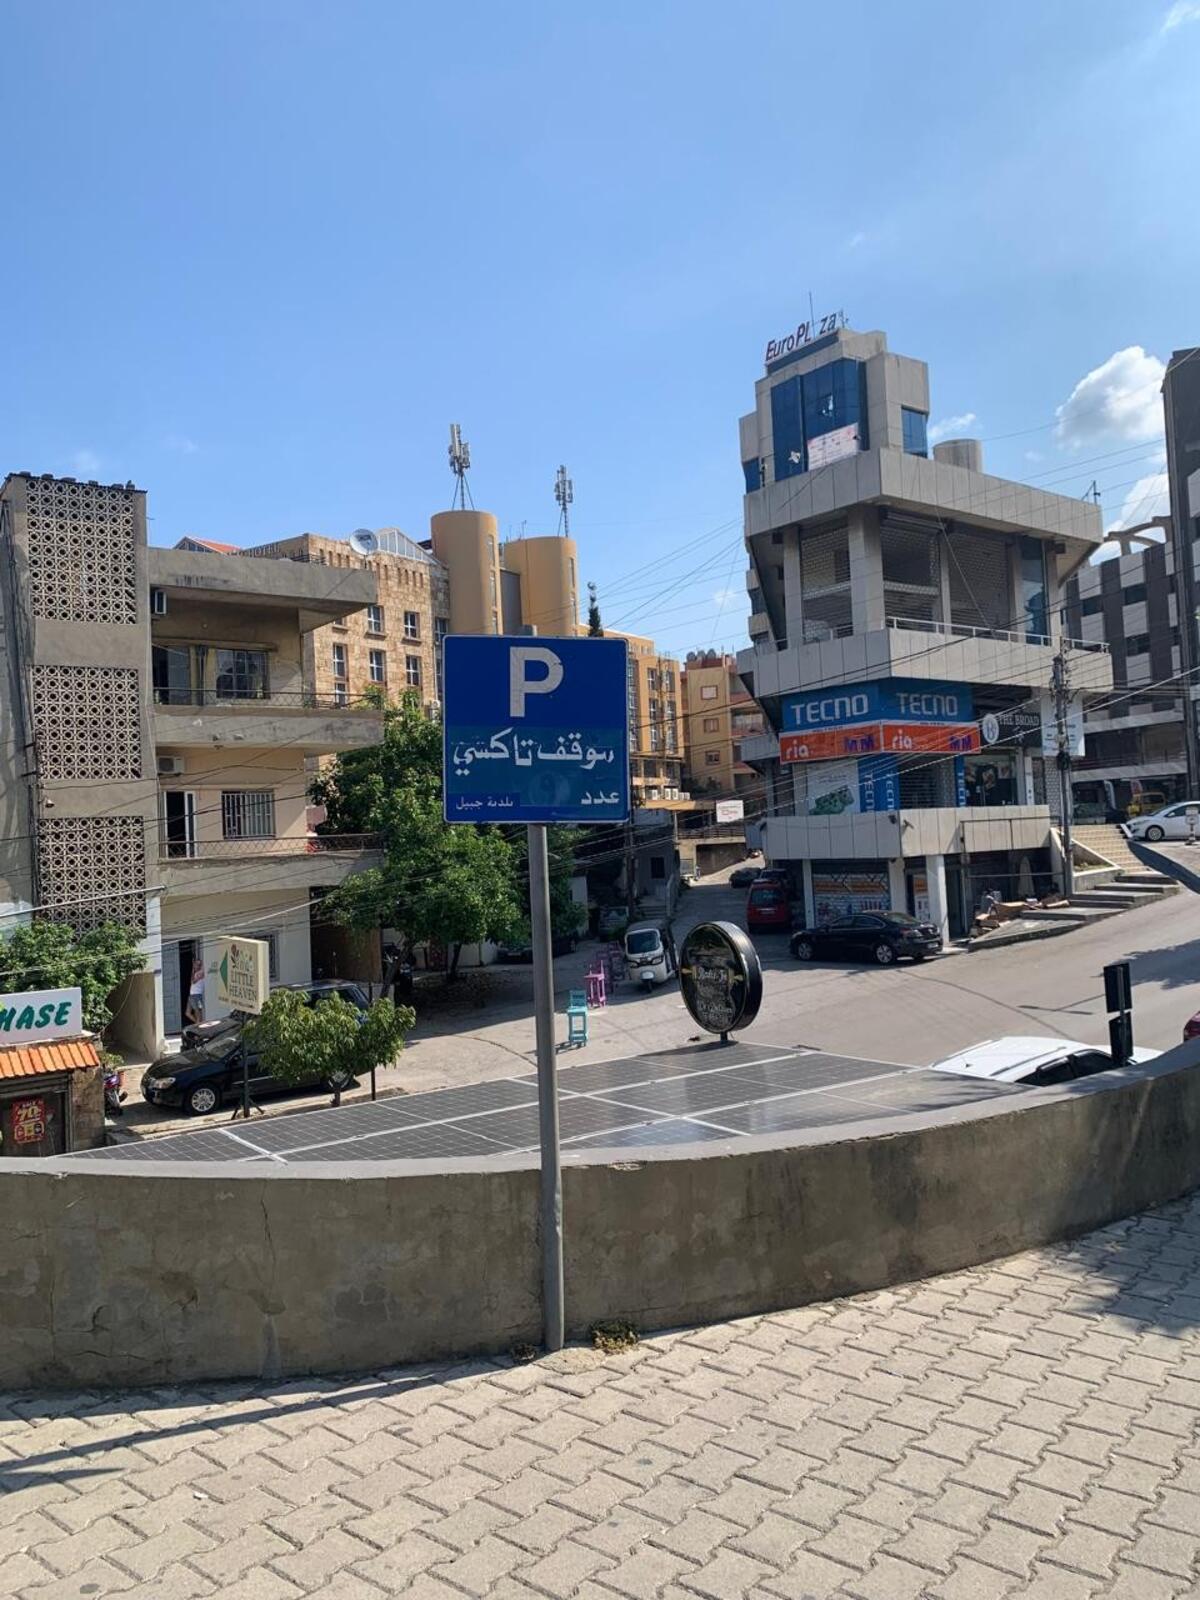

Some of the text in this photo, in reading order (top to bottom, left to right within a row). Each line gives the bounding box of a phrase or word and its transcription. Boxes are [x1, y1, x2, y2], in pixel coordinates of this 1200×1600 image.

[509, 646, 564, 718] P
[790, 694, 869, 726] TECNO
[896, 692, 958, 717] TECNO
[786, 739, 809, 760] ria
[580, 790, 620, 805] عدد
